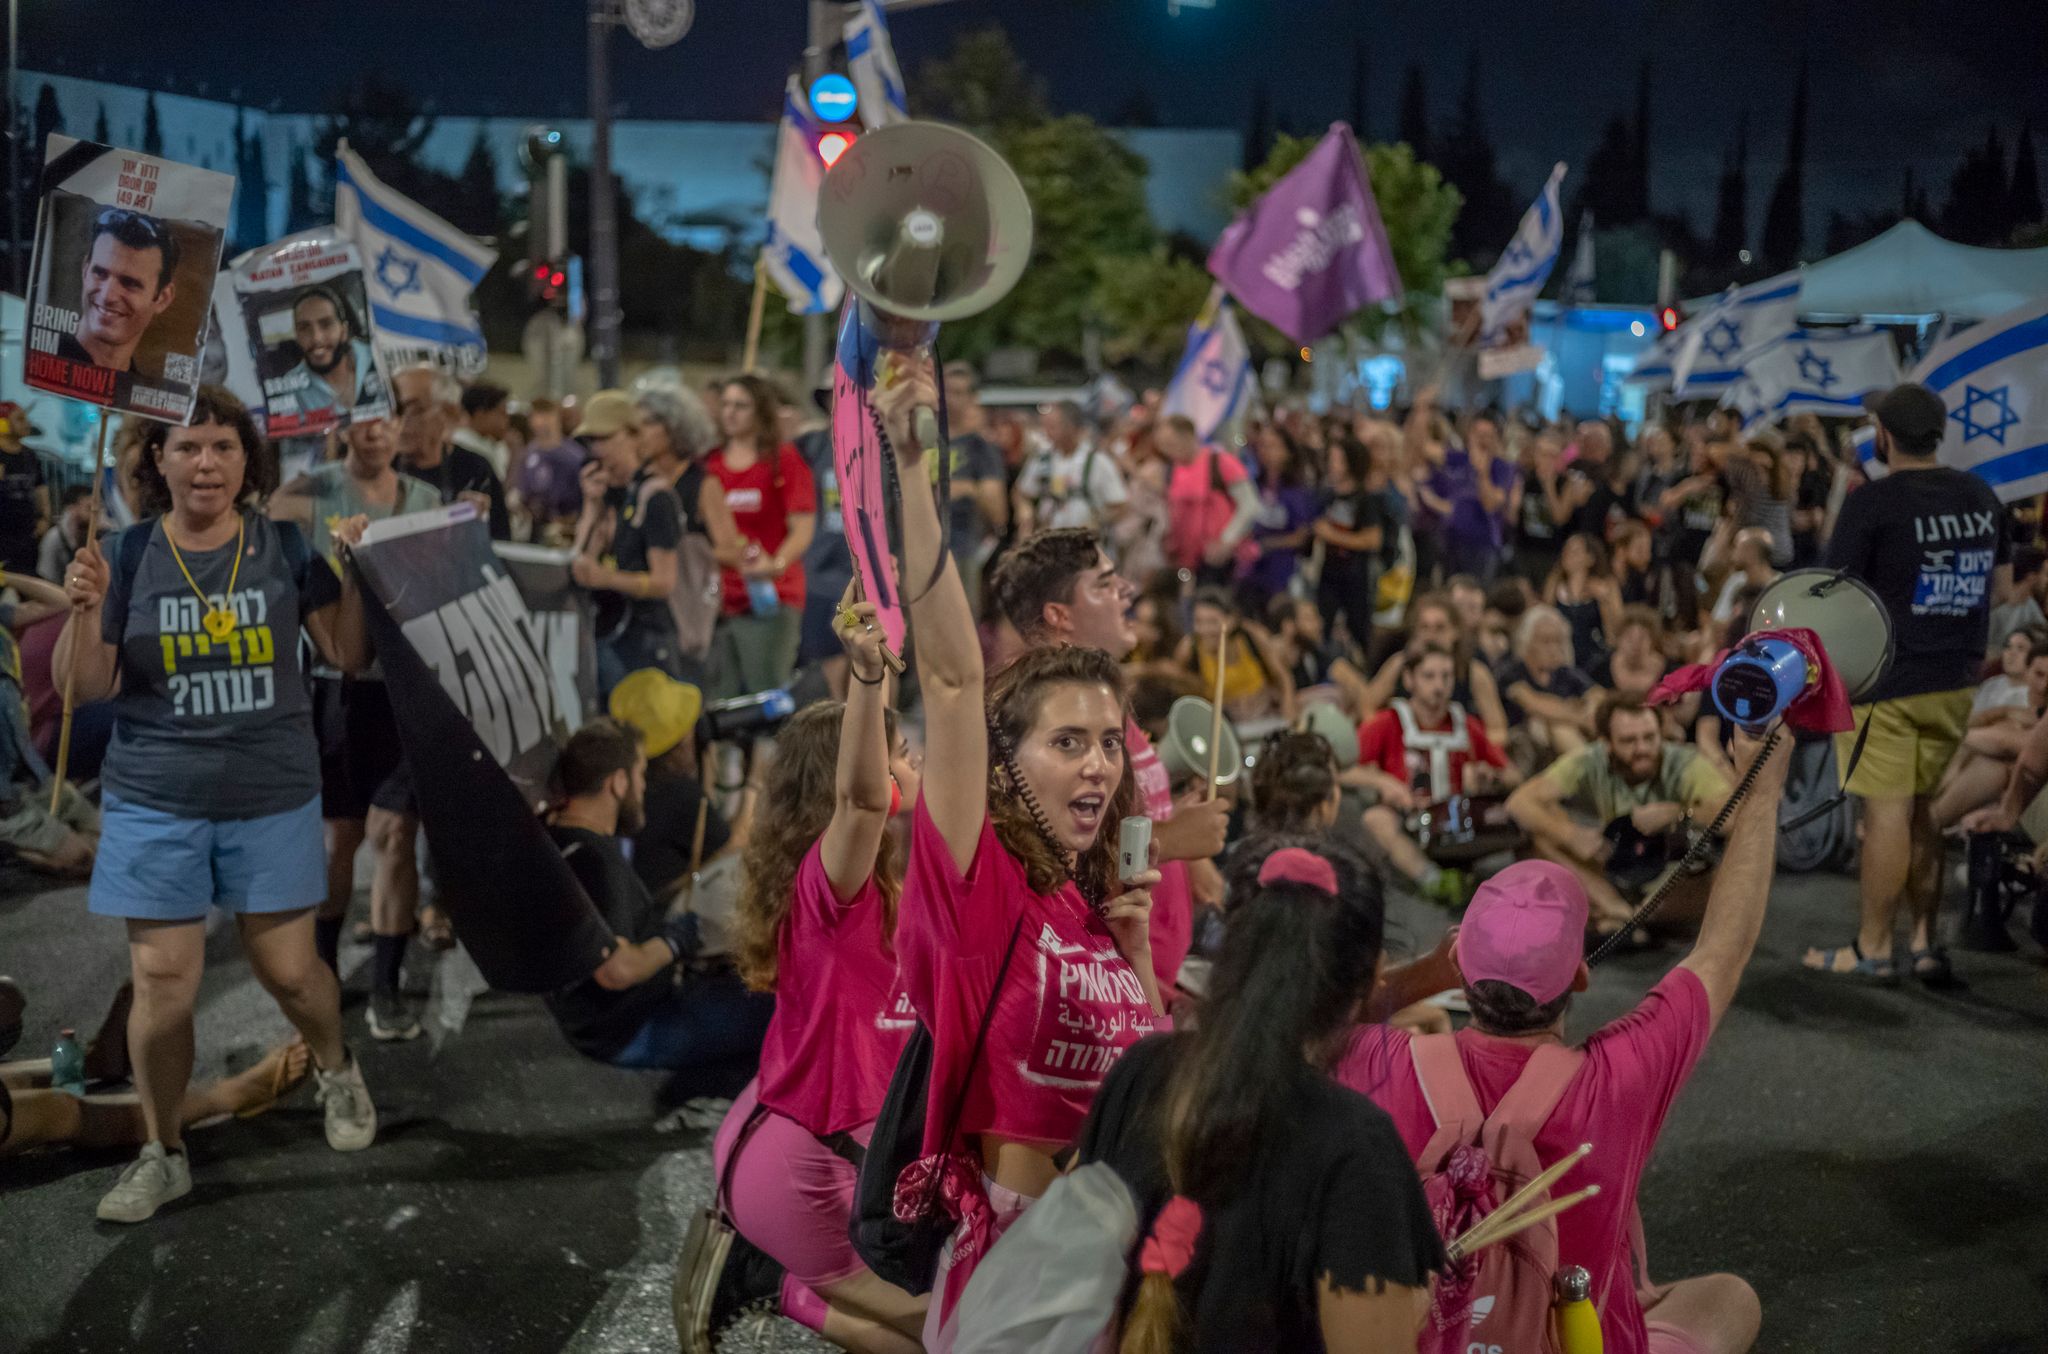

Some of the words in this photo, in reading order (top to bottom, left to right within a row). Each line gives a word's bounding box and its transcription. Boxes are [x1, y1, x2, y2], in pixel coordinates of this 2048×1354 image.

[118, 174, 142, 192] DROR
[33, 303, 80, 334] BRING
[30, 327, 60, 355] HIM
[29, 354, 69, 384] HOME
[72, 363, 118, 395] NOW!
[1914, 510, 1995, 543] אנחנו
[160, 596, 200, 633] הם
[160, 625, 274, 675] עדיין
[1058, 1002, 1126, 1041] الوردية
